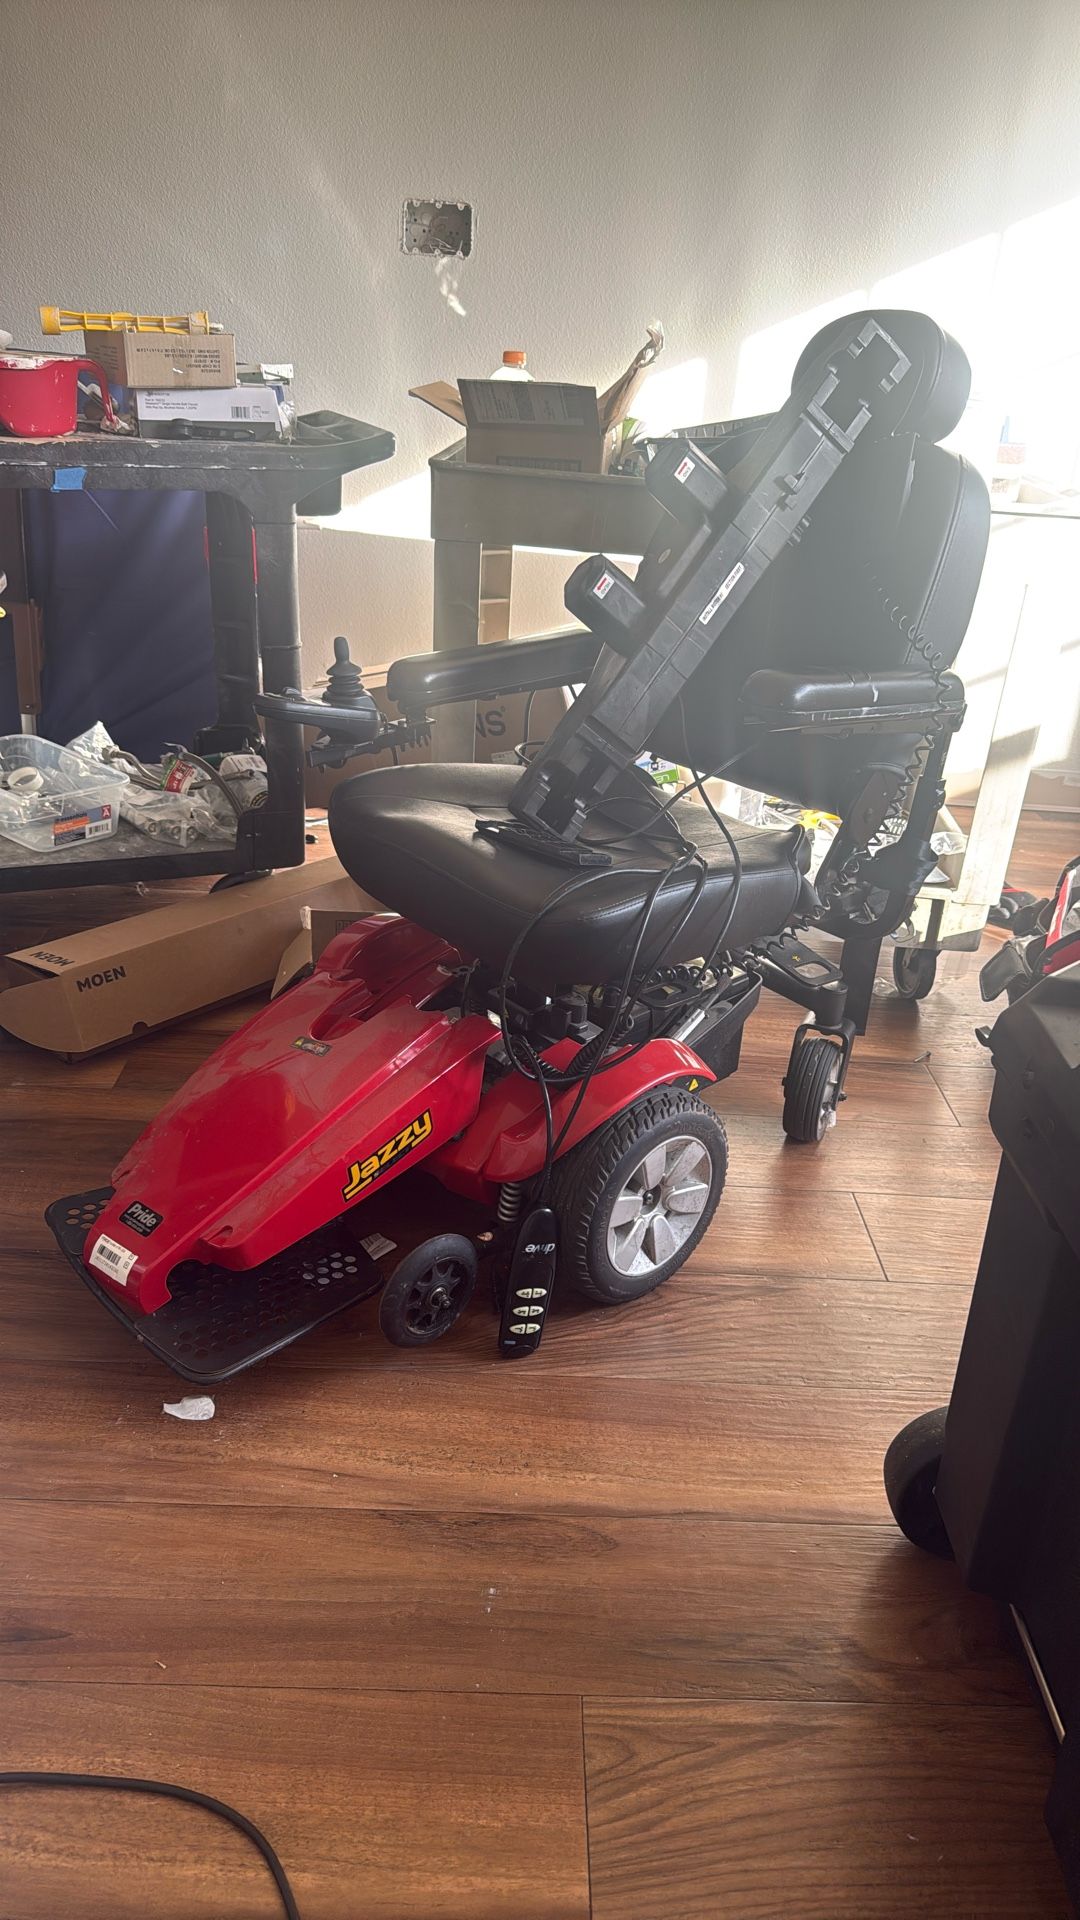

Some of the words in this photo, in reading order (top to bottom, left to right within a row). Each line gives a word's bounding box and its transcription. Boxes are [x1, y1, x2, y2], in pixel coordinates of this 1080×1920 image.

[600, 580, 611, 595] HEAD
[30, 951, 76, 967] MOEN
[76, 965, 127, 993] MOEN
[343, 1111, 432, 1199] Jazzy
[127, 1203, 157, 1227] Pride
[525, 1243, 555, 1254] drive
